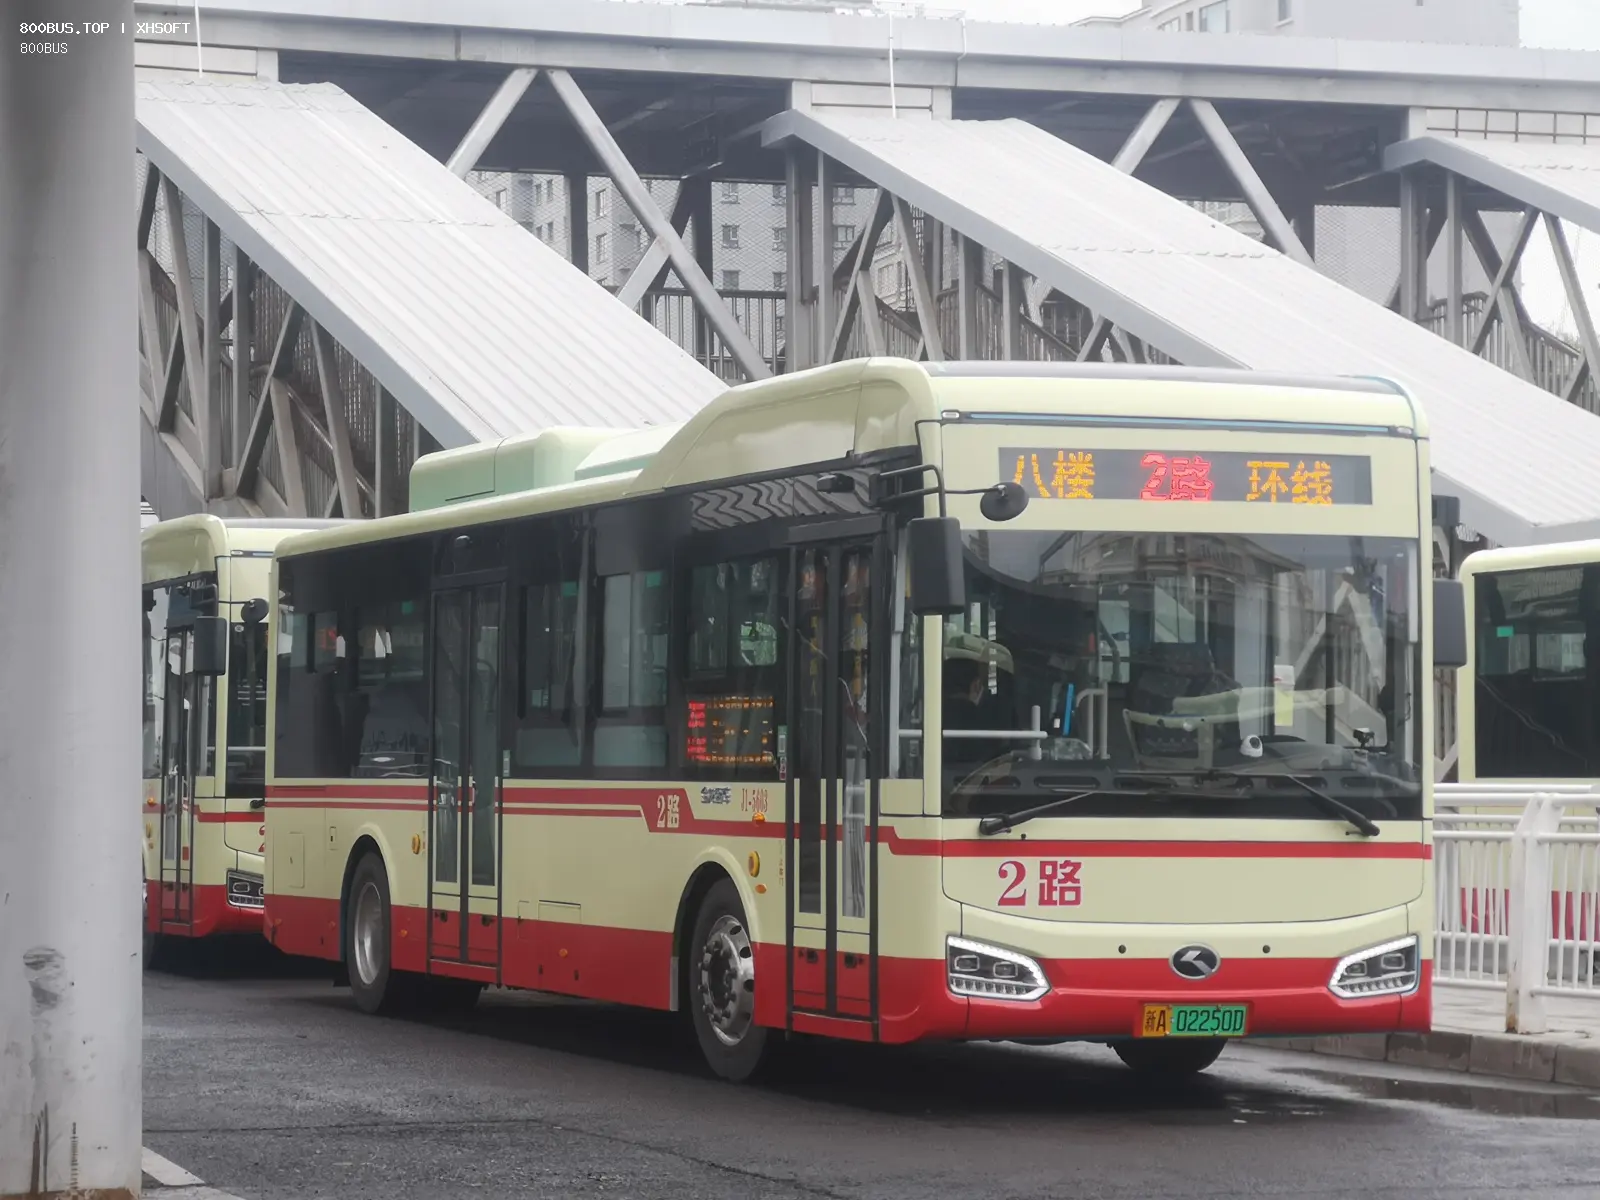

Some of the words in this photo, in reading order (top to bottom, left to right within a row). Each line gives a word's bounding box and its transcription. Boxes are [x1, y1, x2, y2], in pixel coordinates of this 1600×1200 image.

[1012, 450, 1096, 499] 八楼
[1140, 452, 1212, 501] 2路
[1246, 460, 1333, 505] 环线
[656, 794, 680, 828] 2路
[998, 859, 1082, 906] 2路
